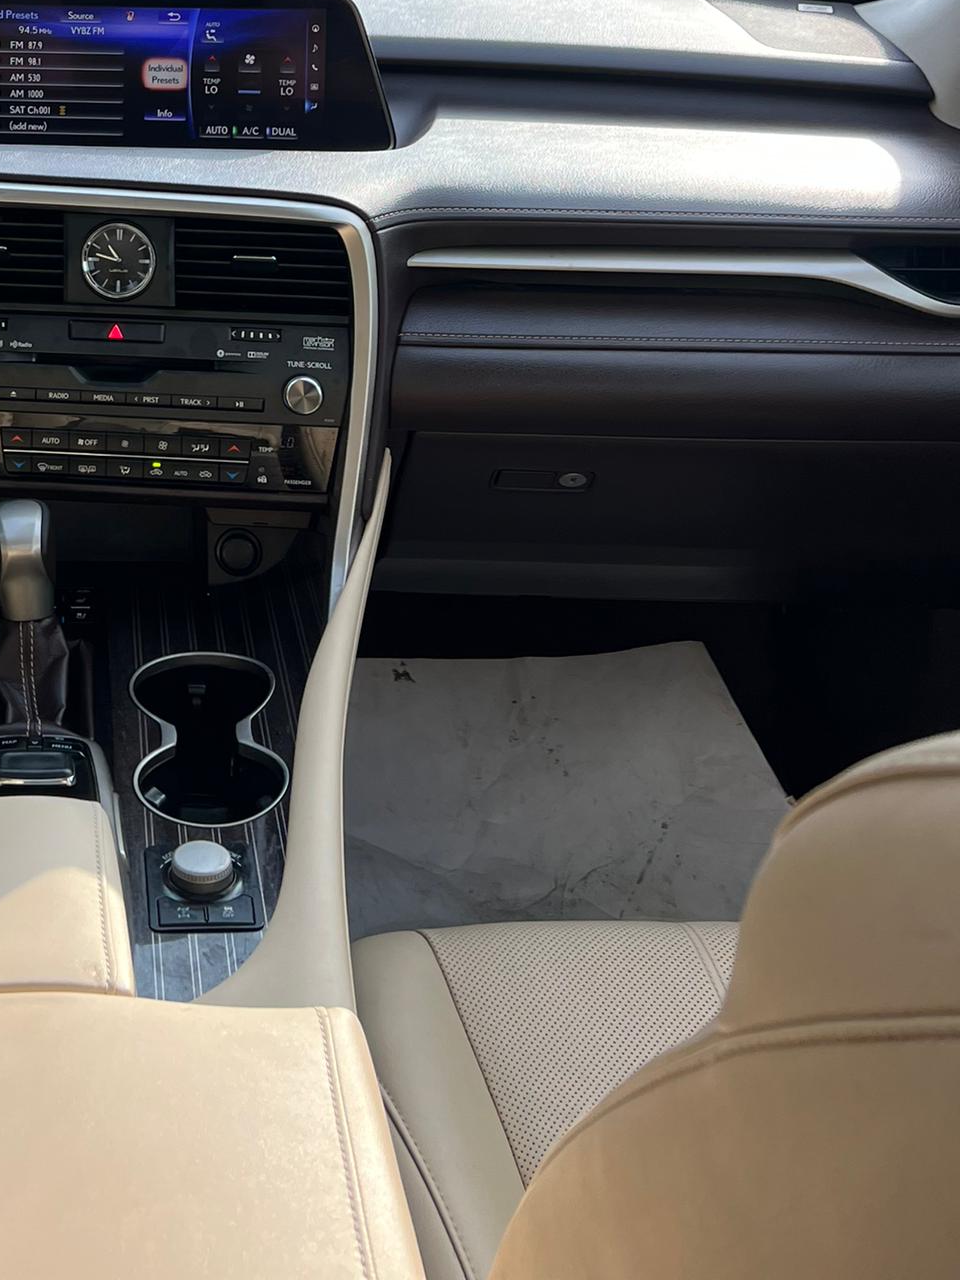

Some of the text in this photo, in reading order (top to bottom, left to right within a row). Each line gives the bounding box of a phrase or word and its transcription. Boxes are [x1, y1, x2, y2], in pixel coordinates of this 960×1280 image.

[5, 10, 39, 20] Presets
[67, 10, 94, 21] Source
[70, 26, 92, 35] VYBZ
[92, 27, 105, 36] FM
[10, 41, 24, 50] FM
[27, 41, 43, 50] 87.9
[10, 57, 24, 66] FM
[27, 57, 41, 66] 98.1
[147, 64, 184, 73] Individual
[9, 74, 24, 82] AM
[27, 74, 41, 82] 530
[151, 75, 180, 85] Presets
[9, 90, 24, 99] AM
[27, 90, 44, 99] 1000
[205, 86, 218, 95] LO
[280, 87, 294, 96] LO
[9, 106, 25, 114] SAT
[157, 109, 173, 118] Info
[9, 121, 27, 131] (add
[28, 122, 48, 131] new)
[205, 127, 229, 136] AUTO
[242, 127, 260, 136] A/C
[271, 127, 297, 137] DUAL
[48, 392, 69, 400] RADIO
[93, 394, 114, 402] MEDIA
[142, 396, 159, 404] PRST
[180, 398, 202, 406] TRACK
[41, 437, 60, 445] AUTO
[84, 438, 98, 447] OFF
